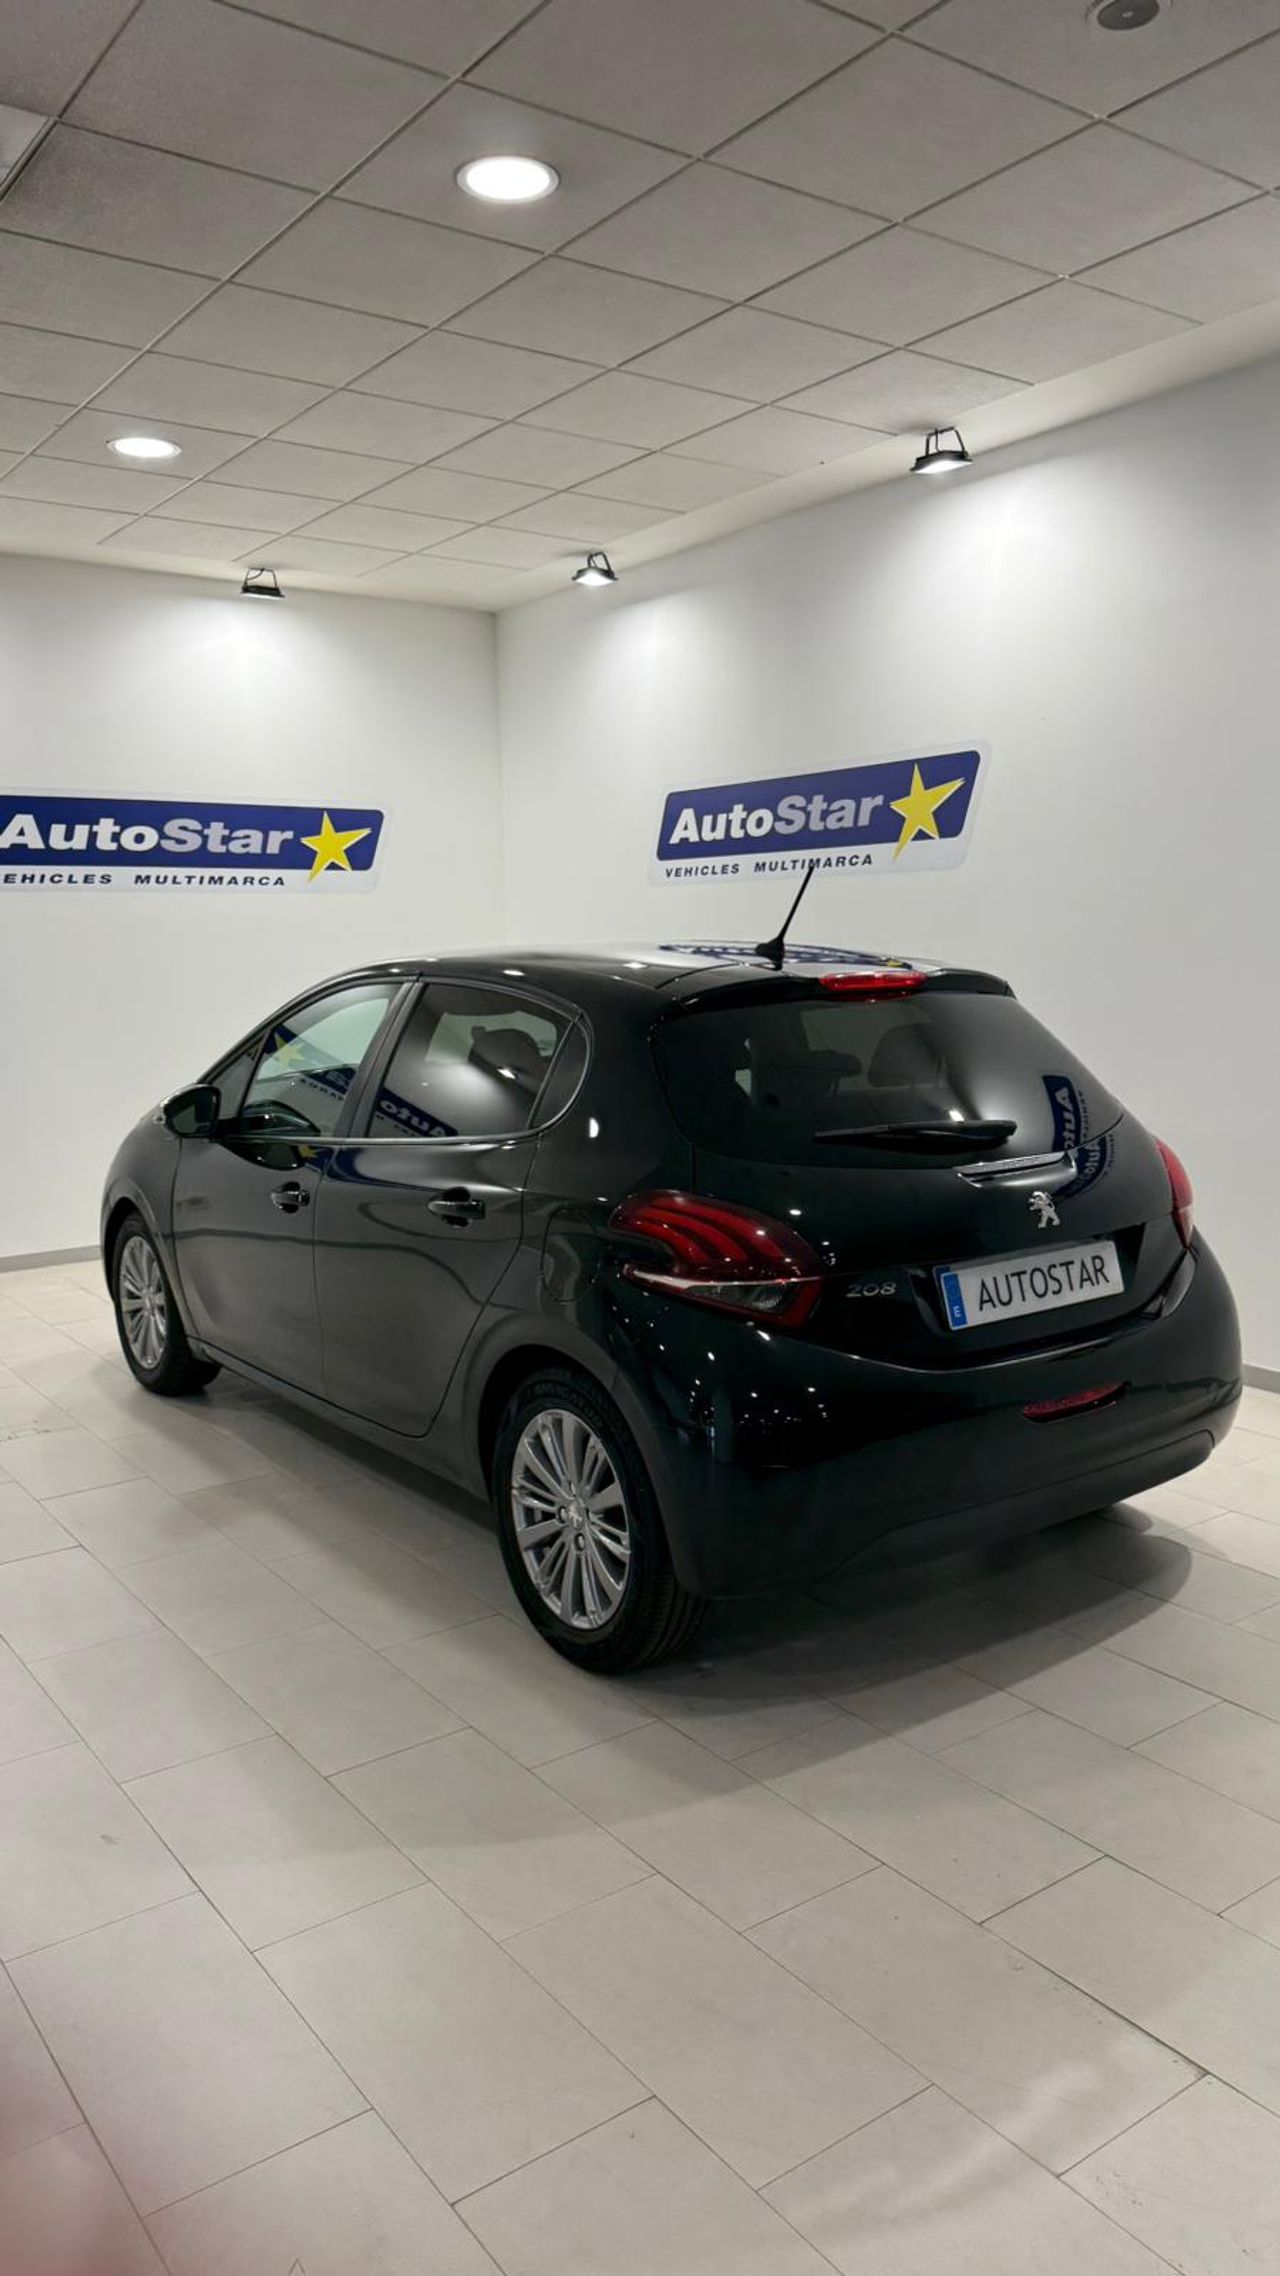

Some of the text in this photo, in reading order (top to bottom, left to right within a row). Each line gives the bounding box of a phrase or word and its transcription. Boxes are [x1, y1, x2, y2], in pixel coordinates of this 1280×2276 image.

[0, 812, 293, 855] AutoStar
[669, 795, 884, 845] AutoStar
[2, 873, 285, 887] EHICLES MULTIMARCA
[665, 853, 873, 878] VEHICLES MULTIMARCA
[846, 1281, 897, 1297] 208
[979, 1254, 1110, 1312] AUTOSTAR
